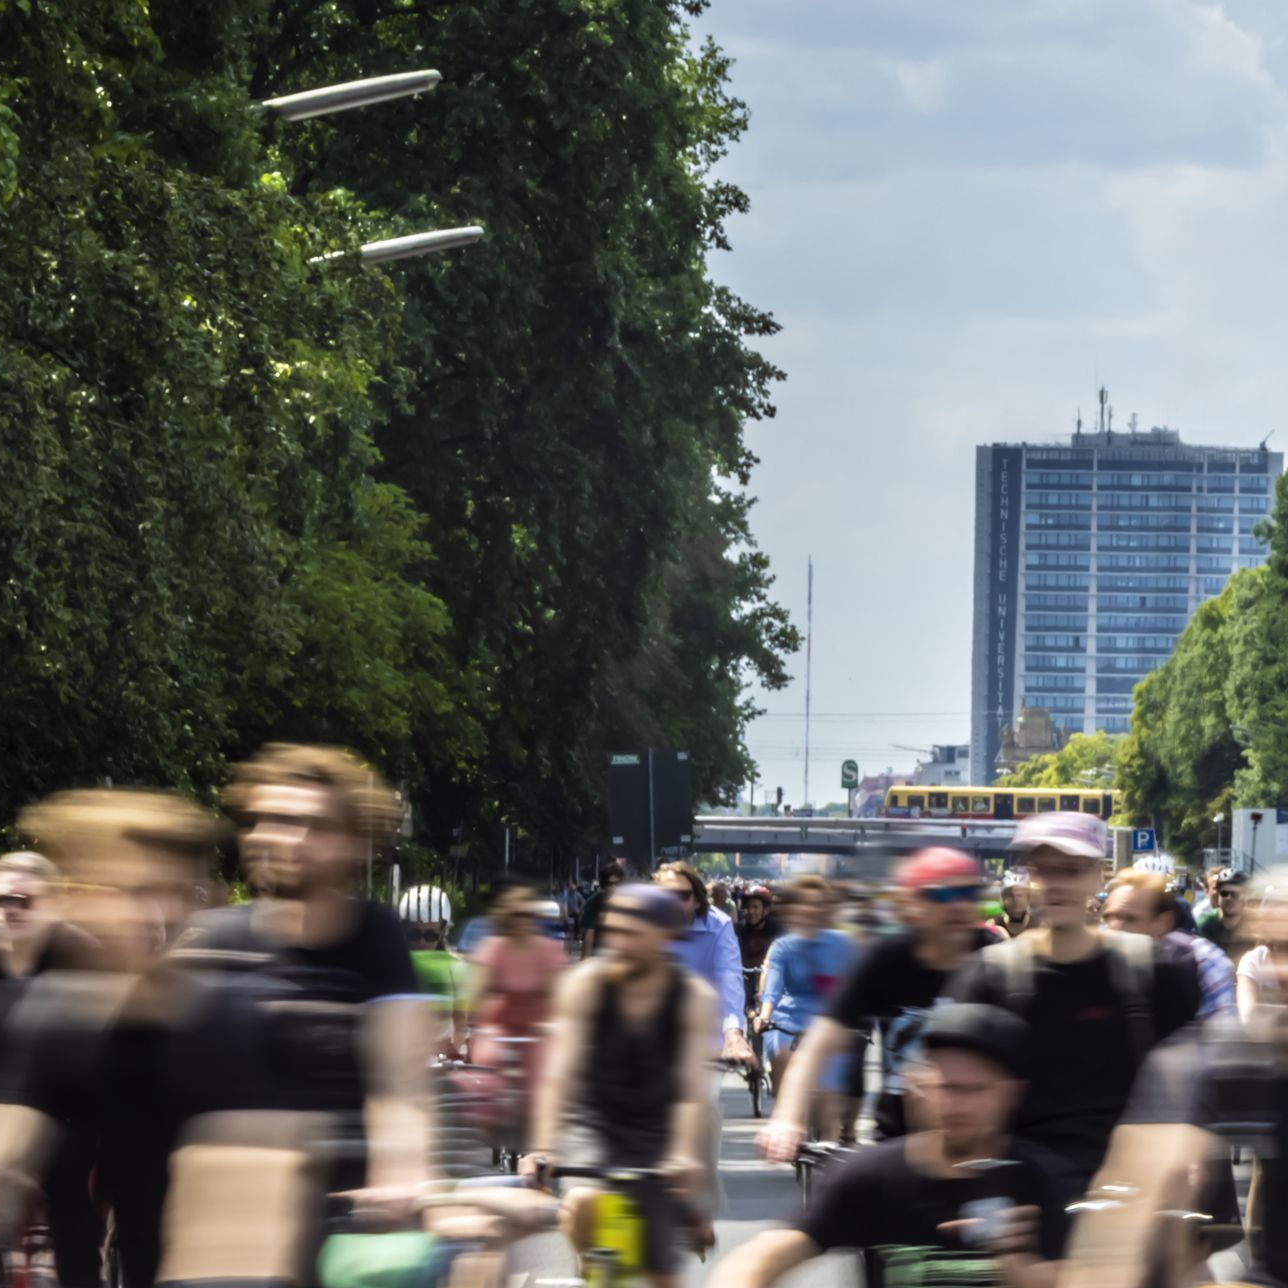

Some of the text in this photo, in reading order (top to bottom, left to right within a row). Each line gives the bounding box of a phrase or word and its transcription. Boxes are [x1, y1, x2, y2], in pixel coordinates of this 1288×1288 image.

[998, 458, 1008, 581] TECHNISCHE
[843, 762, 857, 783] S
[1137, 831, 1150, 849] P
